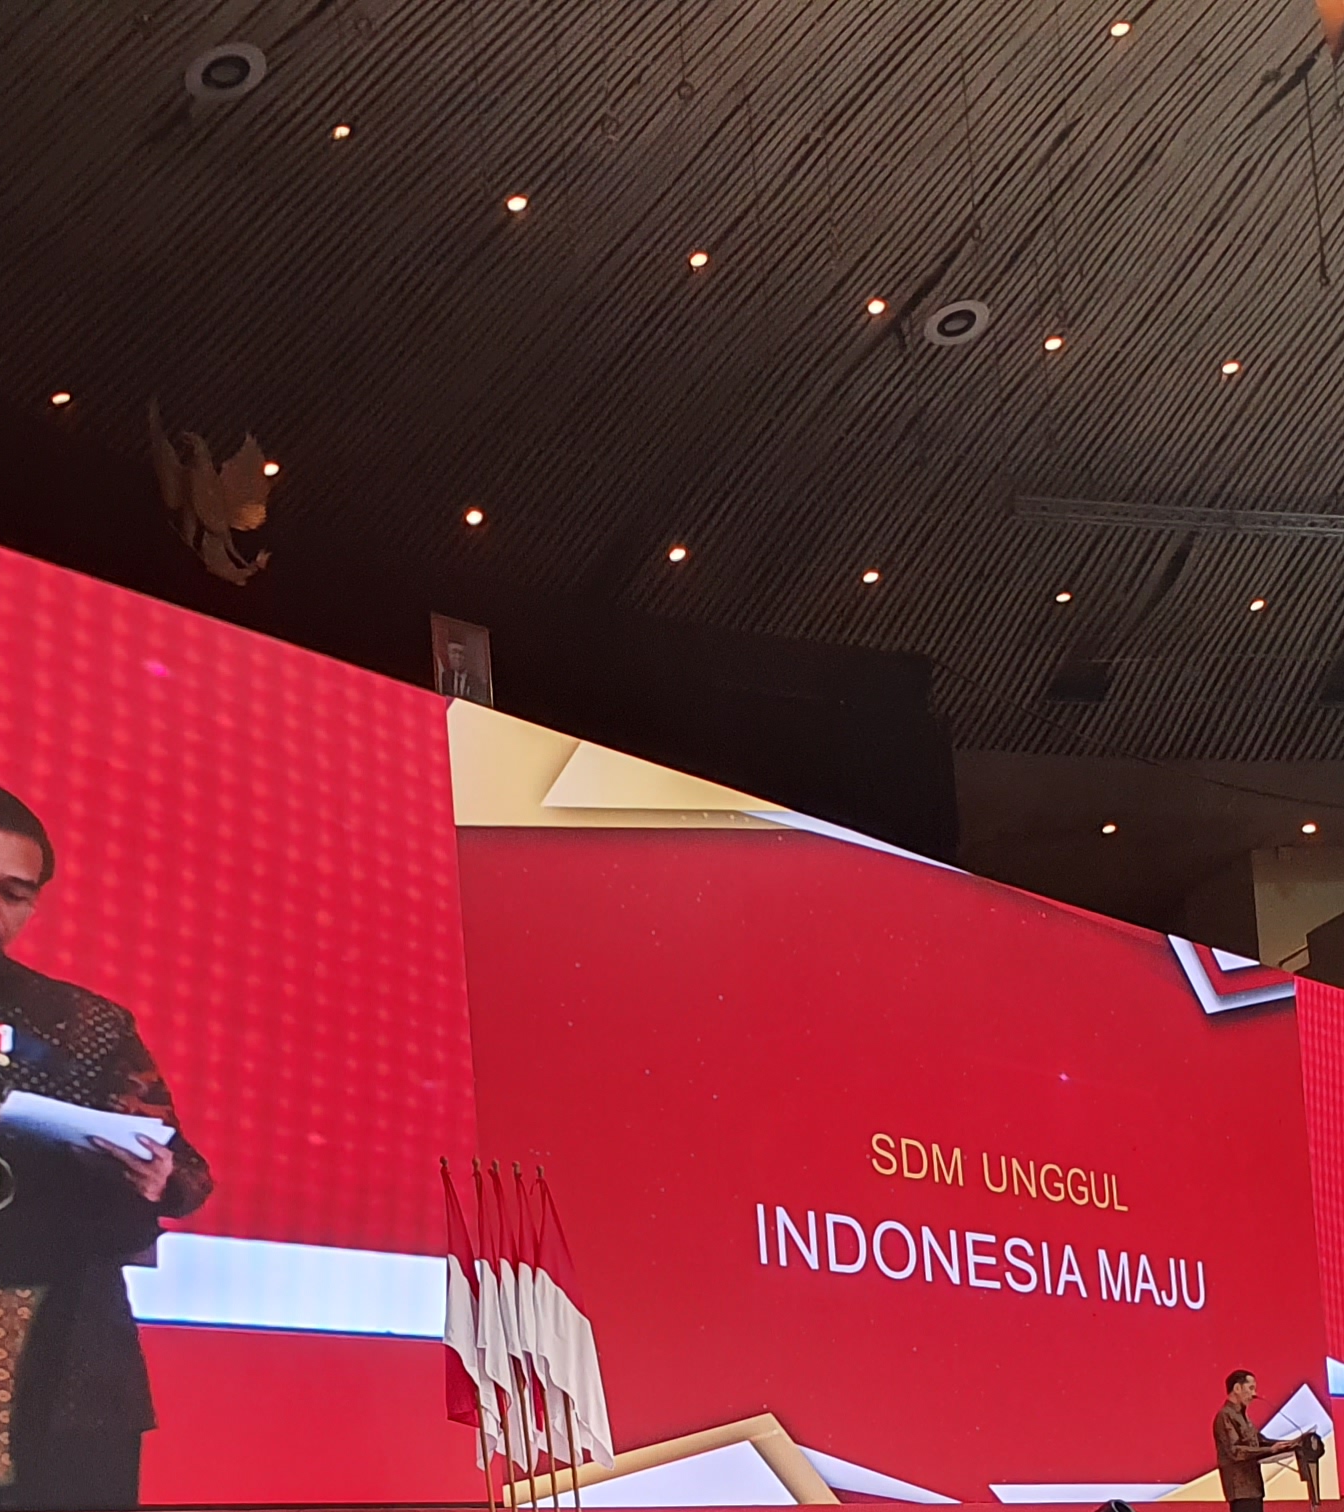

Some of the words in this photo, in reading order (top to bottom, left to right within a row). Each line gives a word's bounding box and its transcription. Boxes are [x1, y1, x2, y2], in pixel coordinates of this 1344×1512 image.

[871, 1132, 964, 1187] SDM
[982, 1152, 1129, 1212] UNGGUL
[756, 1203, 1088, 1299] INDONESIA
[1097, 1248, 1206, 1311] MAJU
